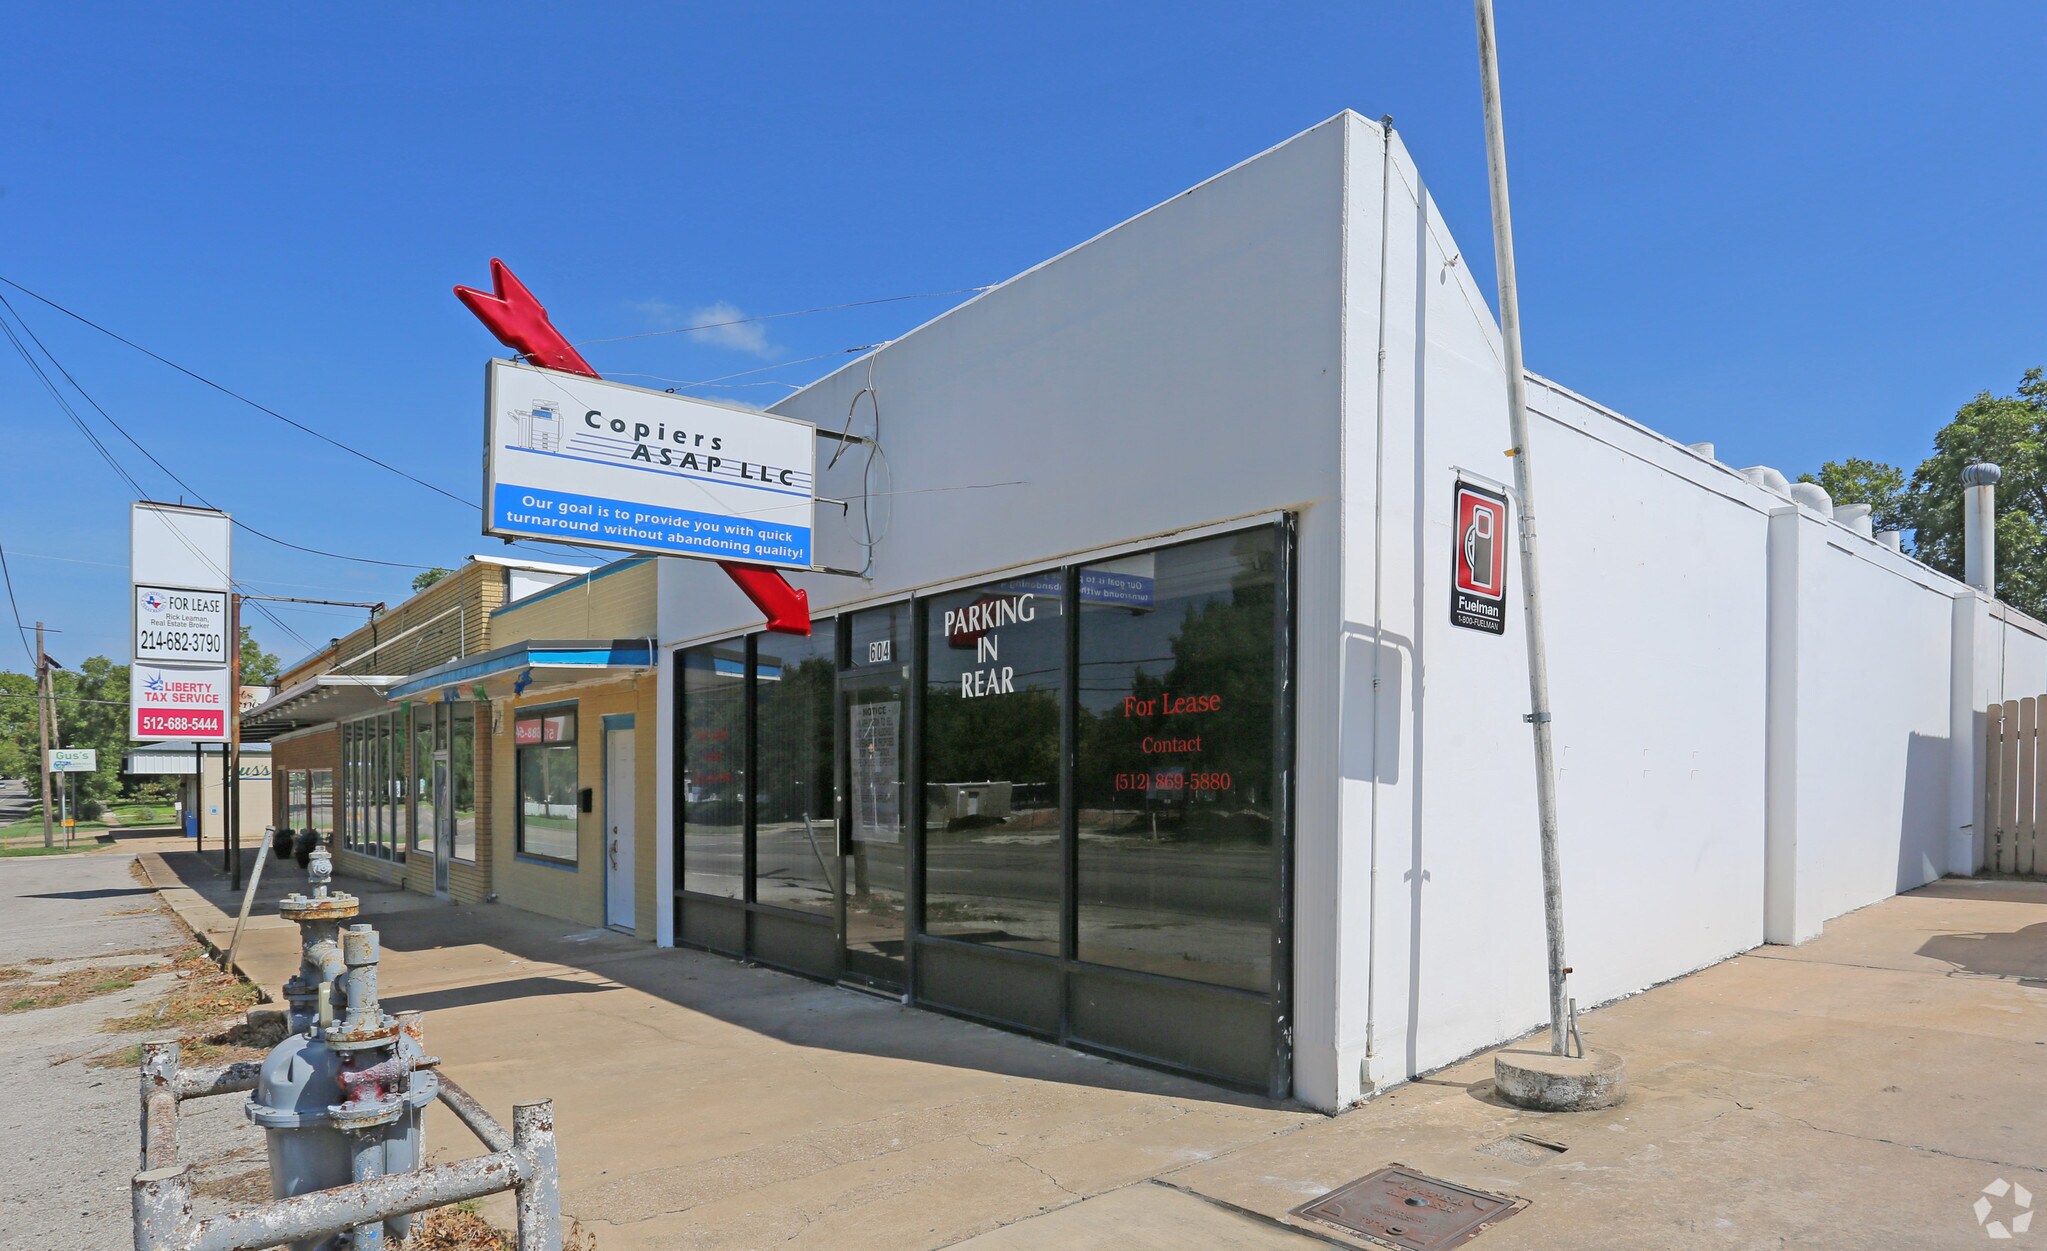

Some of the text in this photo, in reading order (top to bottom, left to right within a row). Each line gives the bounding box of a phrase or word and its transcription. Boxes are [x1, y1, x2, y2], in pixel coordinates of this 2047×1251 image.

[584, 410, 722, 451] Copiers
[630, 443, 793, 486] ASAP LLC
[522, 495, 793, 542] Our goal is to provide you with quick
[506, 511, 803, 560] turnaround without abandoning quality!
[169, 596, 189, 611] FOR
[192, 598, 220, 613] LEASE
[1458, 595, 1499, 617] Fuelman
[167, 620, 188, 628] Estate
[944, 593, 1035, 637] PARKING
[1458, 615, 1499, 631] 1-800-FUELMAN
[141, 630, 221, 653] 214-682-3790
[870, 641, 890, 661] 604
[977, 634, 998, 664] IN
[165, 682, 213, 693] LIBERTY
[961, 666, 1014, 698] REAR
[144, 692, 220, 704] TAX SERVICE
[1124, 693, 1221, 717] For Lease
[143, 716, 219, 731] 512-688-5444
[1142, 736, 1202, 753] Contact
[56, 751, 89, 760] Gus's
[230, 765, 271, 777] us's
[1115, 772, 1231, 791] (512) 869-5880
